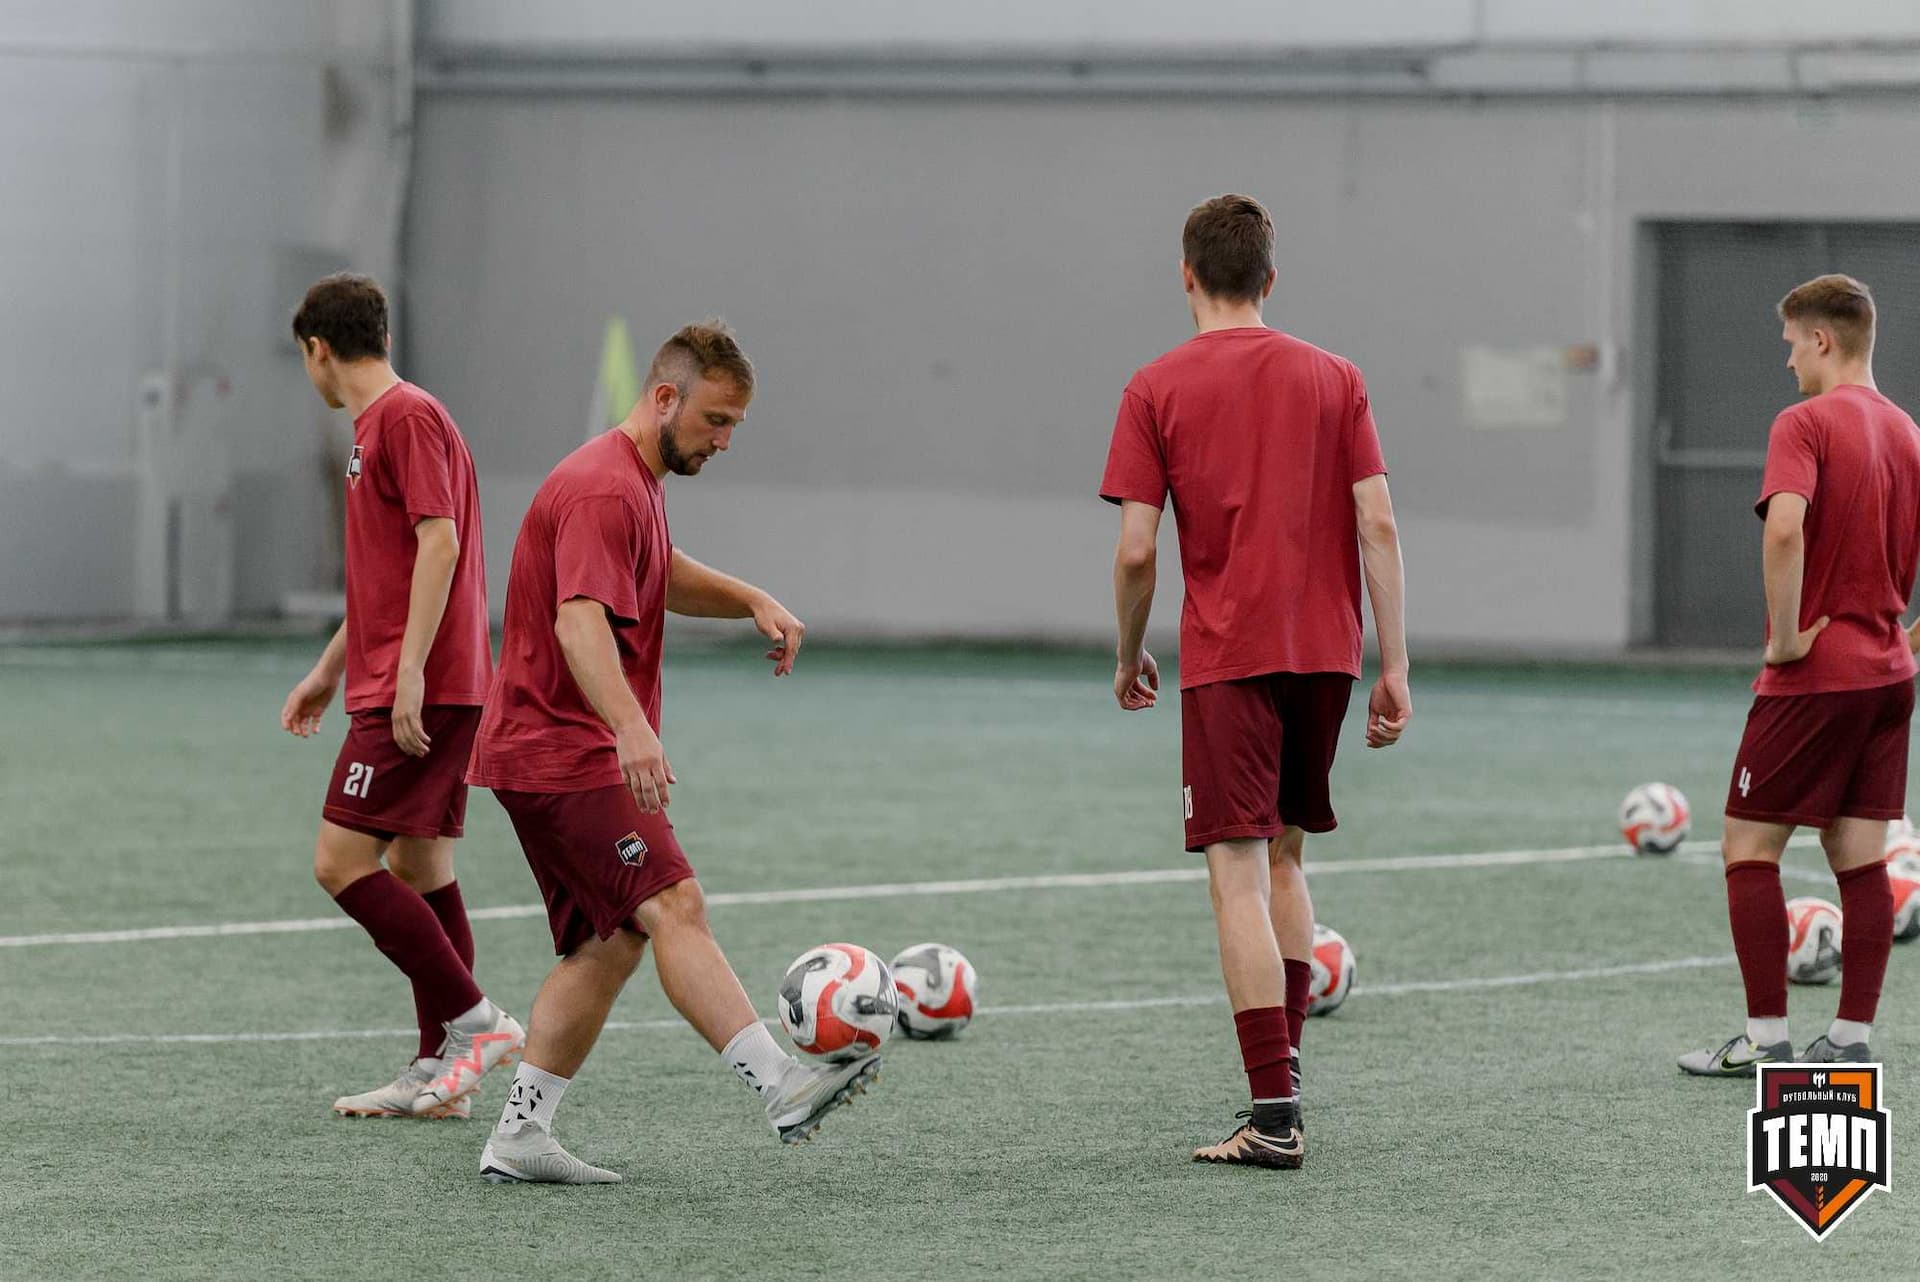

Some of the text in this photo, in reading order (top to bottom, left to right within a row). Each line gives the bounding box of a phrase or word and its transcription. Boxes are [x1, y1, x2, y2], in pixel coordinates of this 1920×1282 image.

[343, 761, 375, 799] 21
[1739, 766, 1752, 798] 4
[621, 840, 645, 861] ТЕМП
